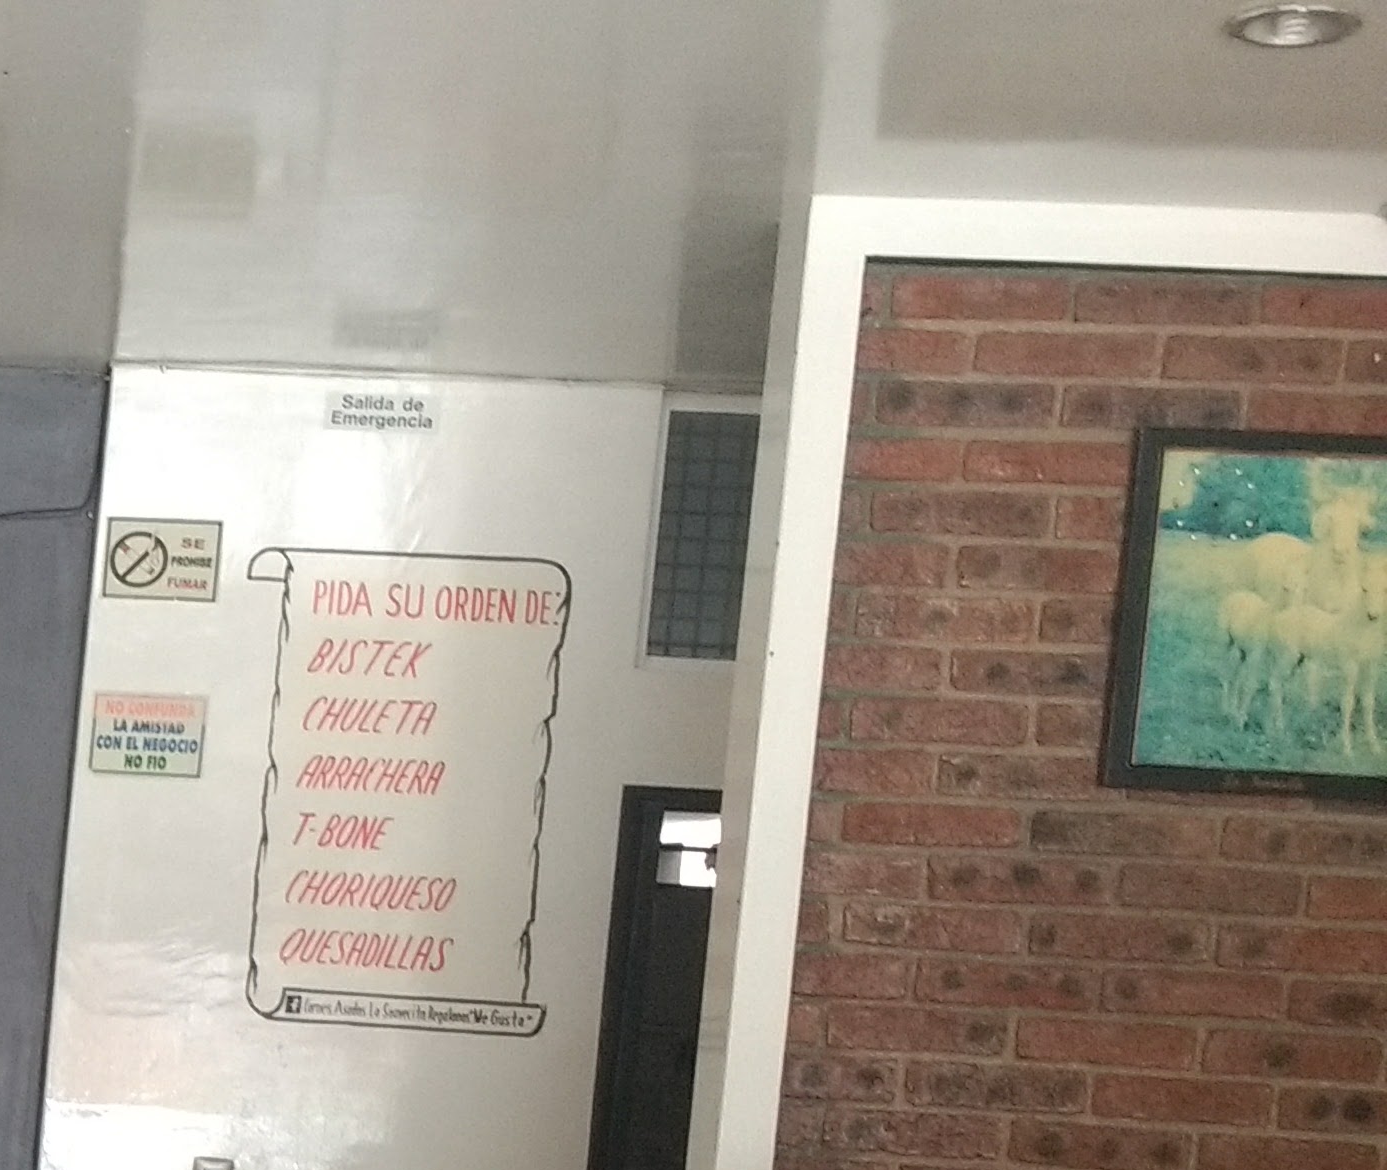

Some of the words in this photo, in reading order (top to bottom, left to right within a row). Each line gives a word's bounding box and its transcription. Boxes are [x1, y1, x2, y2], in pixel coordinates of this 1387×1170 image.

[341, 394, 395, 410] Salida
[402, 396, 425, 412] de
[331, 410, 433, 430] Emergencia
[180, 537, 205, 550] SE
[167, 576, 208, 590] FUMAR
[312, 579, 372, 617] PIDA
[385, 583, 425, 618] SU
[434, 585, 517, 624] ORDEN
[307, 637, 433, 678] BISTEK
[113, 718, 128, 732] LA
[131, 719, 185, 735] AMISTAD
[302, 696, 439, 736] CHULETA
[96, 734, 122, 750] CON
[126, 736, 139, 751] EL
[142, 736, 199, 754] NEGOCIO
[123, 753, 143, 769] NO
[146, 755, 168, 770] FIO
[295, 754, 446, 795] ARRACHERA
[292, 812, 395, 851] T-BONE
[285, 869, 457, 912] CHORIQUESO
[279, 928, 455, 972] QUESADILLAS
